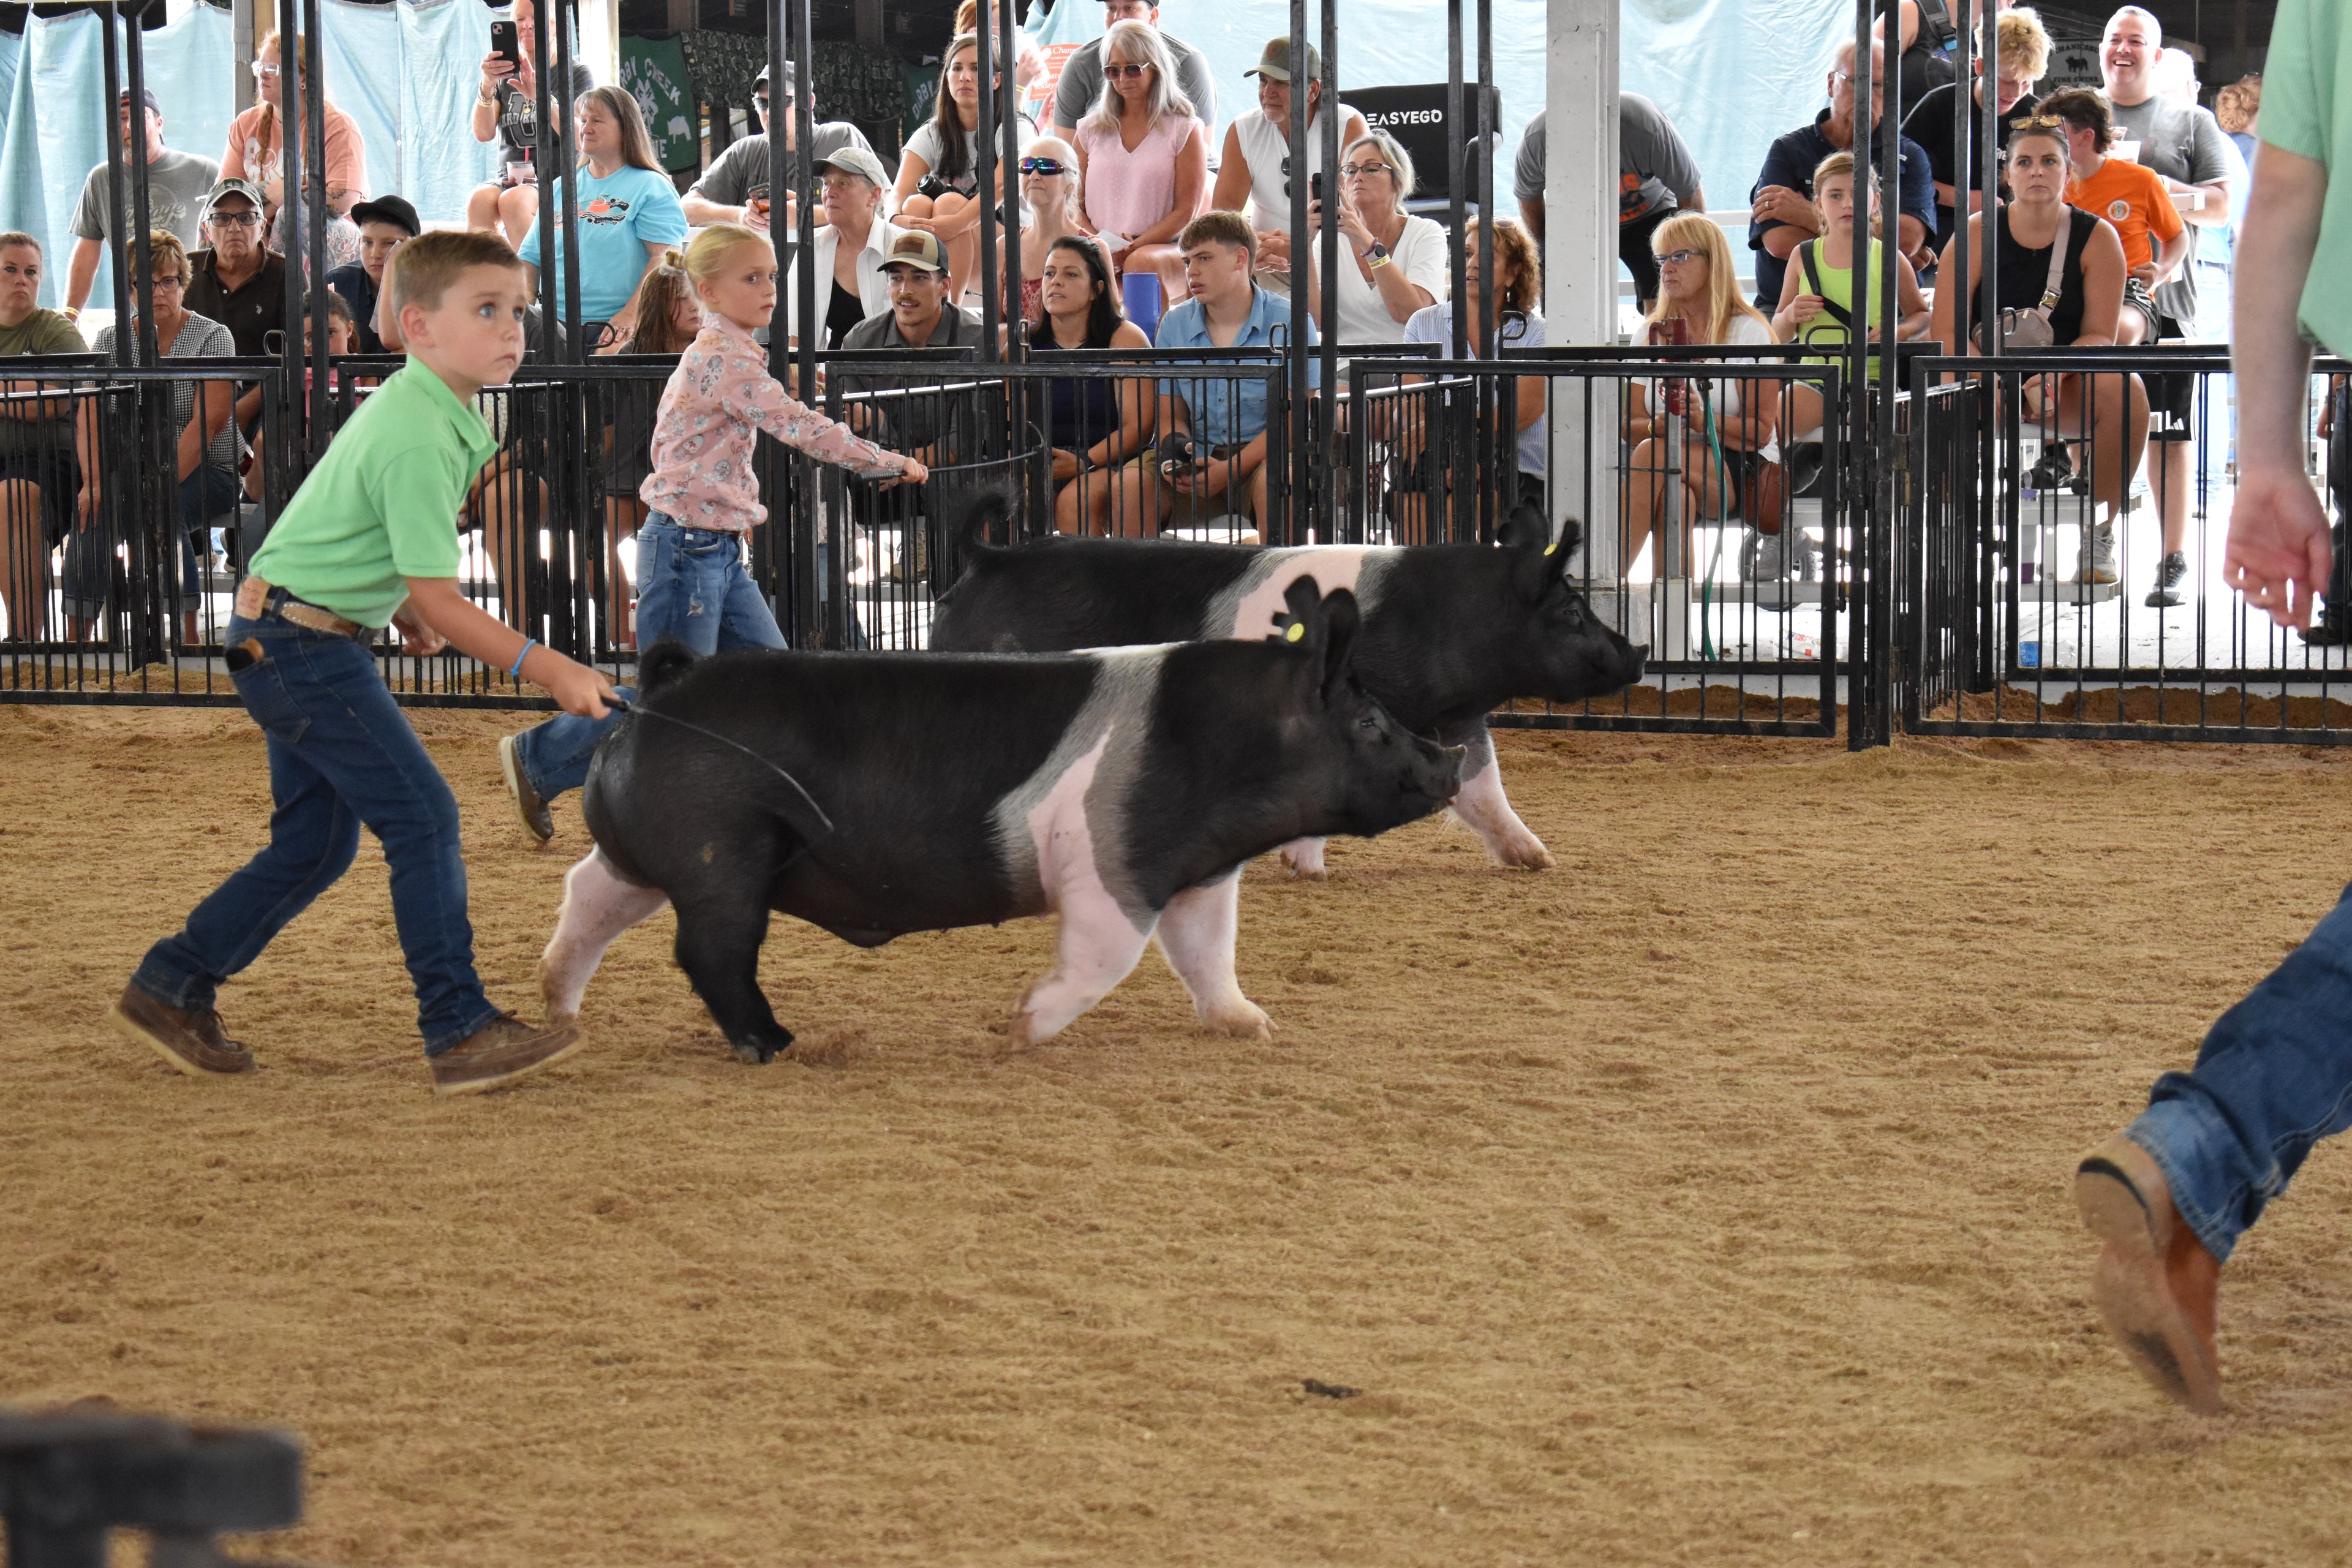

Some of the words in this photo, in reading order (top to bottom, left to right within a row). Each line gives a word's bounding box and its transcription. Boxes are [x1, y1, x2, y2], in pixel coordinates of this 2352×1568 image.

[644, 58, 681, 107] CREEK
[912, 80, 933, 121] DARBY
[1366, 109, 1442, 126] EASYEGO
